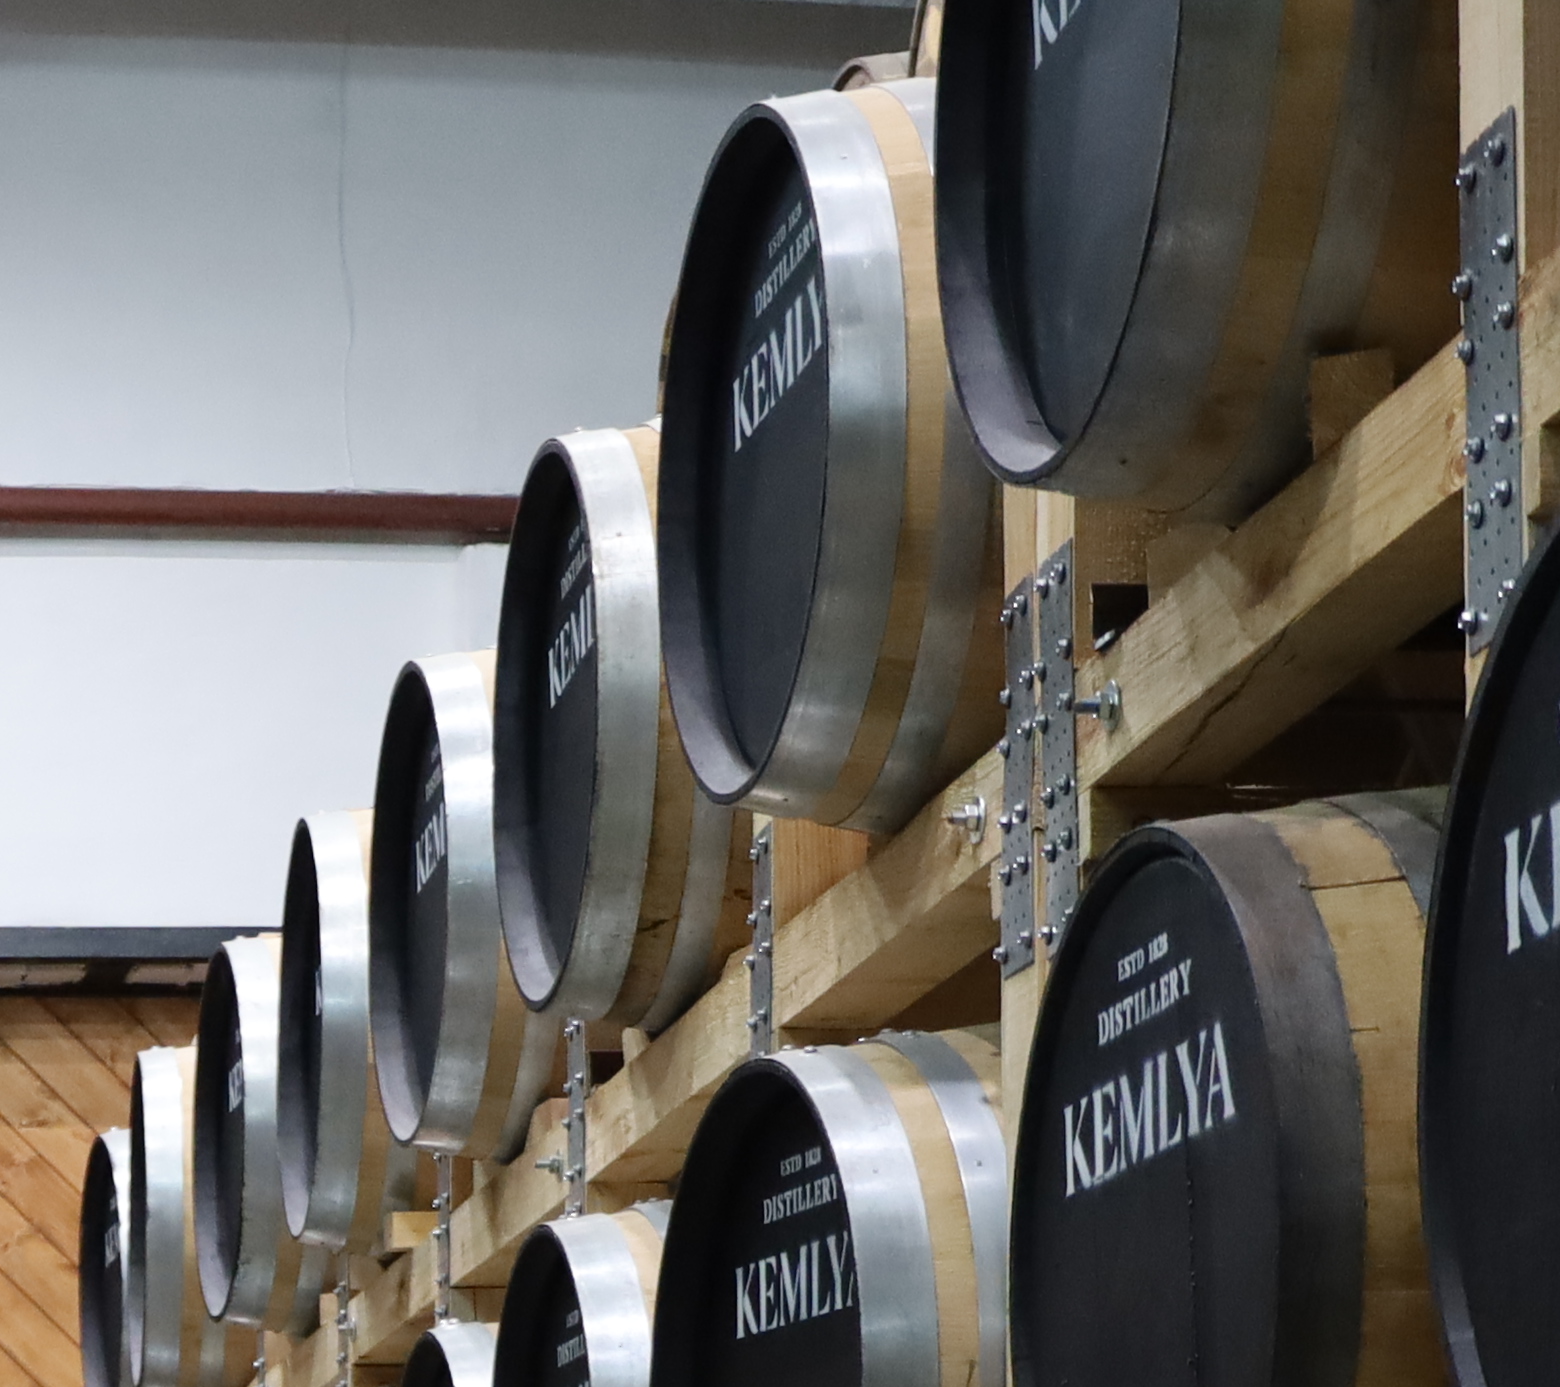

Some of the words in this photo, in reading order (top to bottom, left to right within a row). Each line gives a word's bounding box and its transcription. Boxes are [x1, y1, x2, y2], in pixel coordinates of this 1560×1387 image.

[732, 276, 824, 452] KEMLY
[548, 583, 596, 709] KEML
[1097, 958, 1192, 1046] DISTILLERY
[1063, 1020, 1236, 1198] KEMLYA
[735, 1230, 856, 1340] KEMLY
